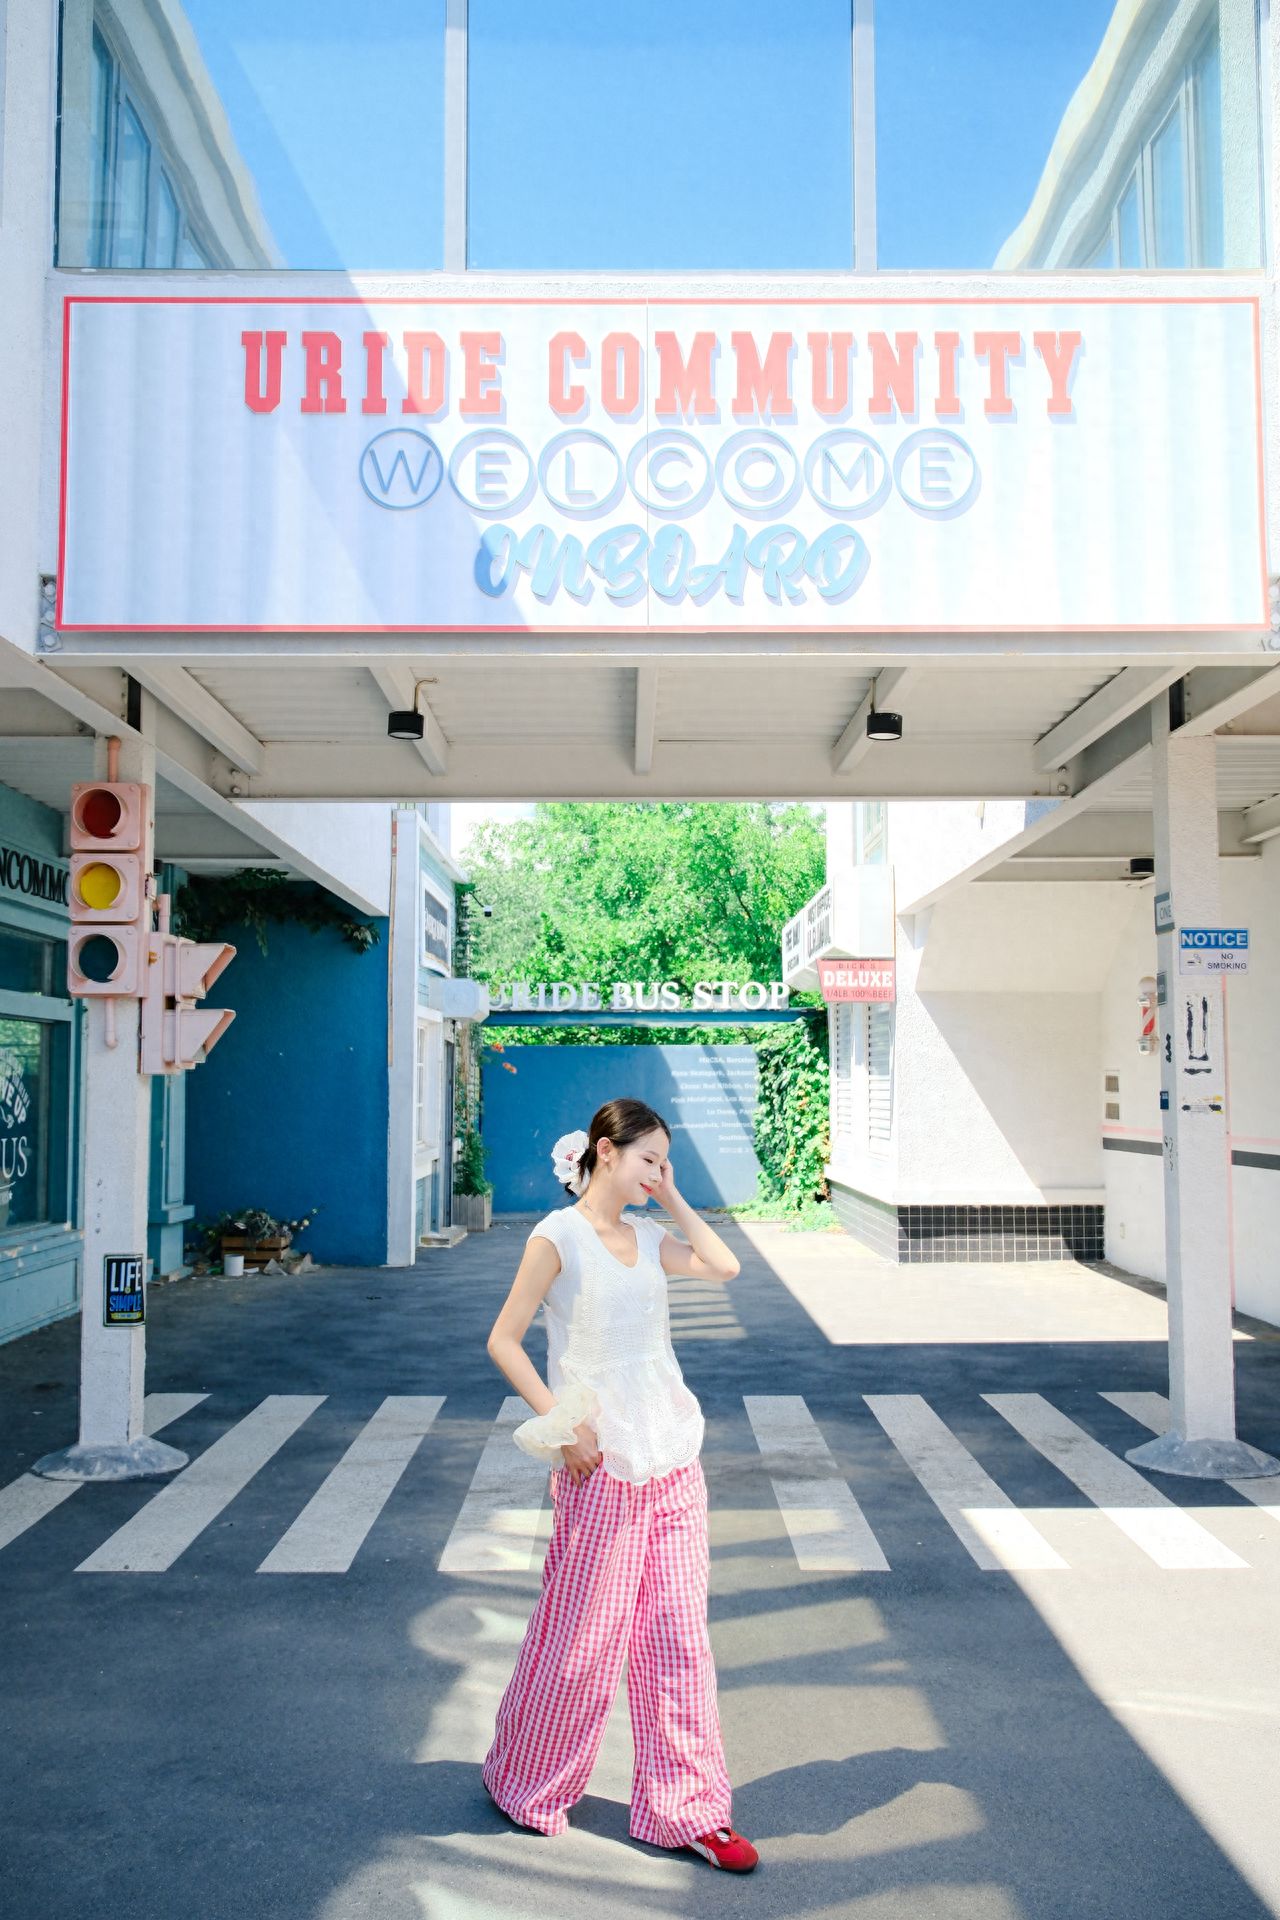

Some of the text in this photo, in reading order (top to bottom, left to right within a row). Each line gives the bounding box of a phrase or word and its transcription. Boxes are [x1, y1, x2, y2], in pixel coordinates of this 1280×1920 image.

[241, 331, 1082, 415] URIDE COMMUNITY
[366, 444, 960, 498] WELCOME
[1181, 932, 1248, 946] NOTICE
[823, 970, 893, 988] DELUXE
[611, 981, 681, 1011] BUS
[694, 981, 790, 1011] STOP
[1, 1136, 28, 1178] US
[110, 1262, 142, 1293] LIFE
[109, 1295, 142, 1312] SIMPLE
